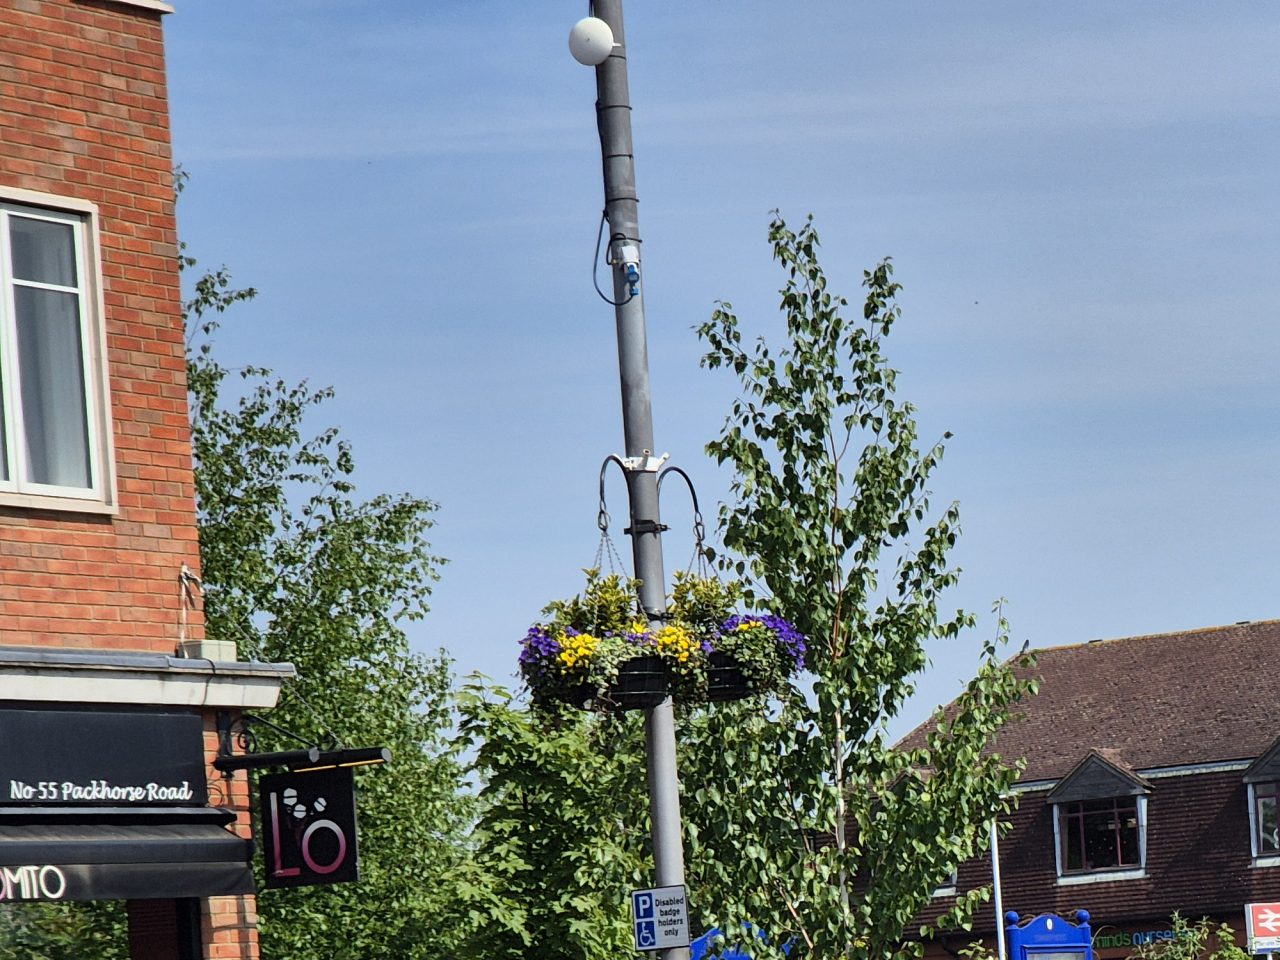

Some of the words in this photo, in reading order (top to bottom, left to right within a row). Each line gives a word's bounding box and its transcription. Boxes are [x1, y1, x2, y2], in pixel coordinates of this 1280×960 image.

[38, 782, 57, 799] 55
[61, 780, 147, 801] Packhorse
[147, 781, 193, 801] Road
[0, 865, 66, 900] MITO
[638, 895, 651, 917] P
[654, 896, 684, 907] Disabled
[659, 908, 680, 917] badge
[657, 918, 684, 927] holders
[664, 928, 679, 937] only
